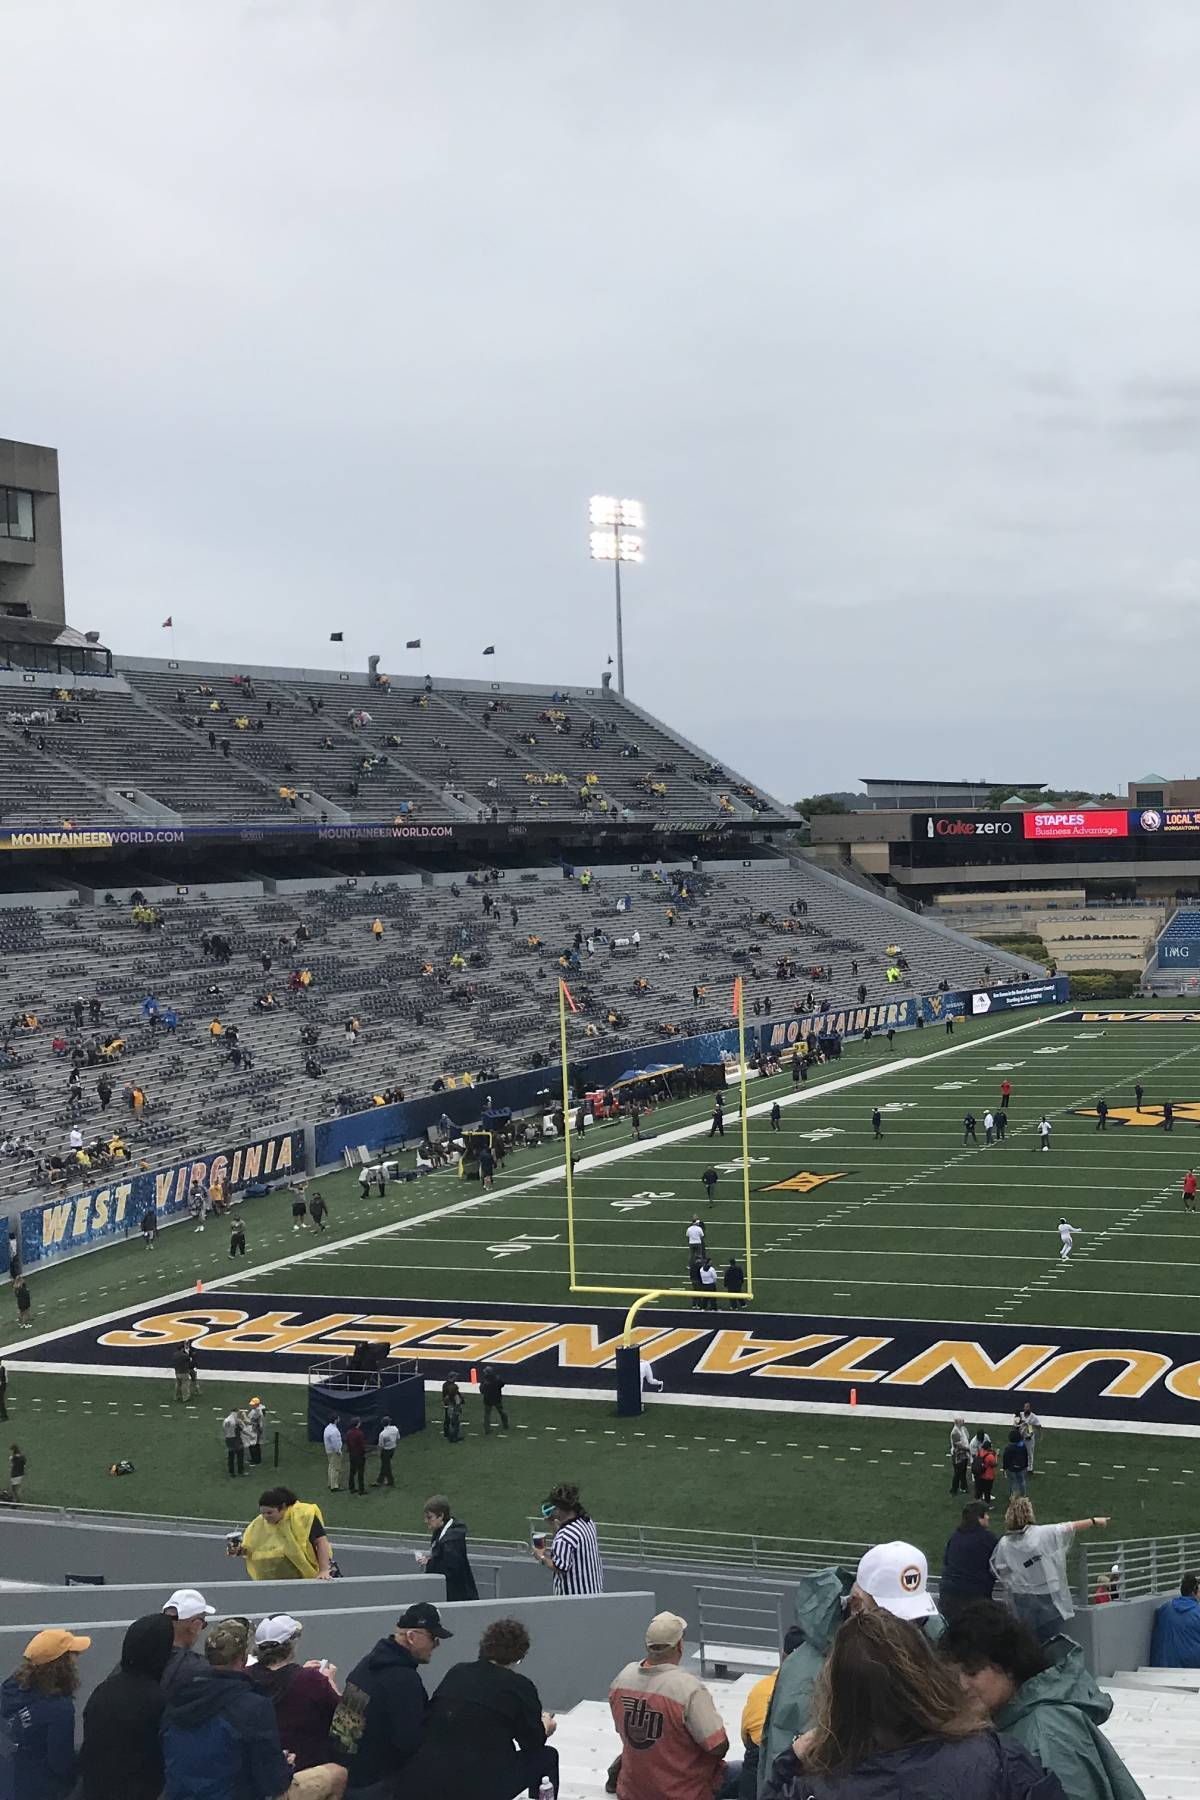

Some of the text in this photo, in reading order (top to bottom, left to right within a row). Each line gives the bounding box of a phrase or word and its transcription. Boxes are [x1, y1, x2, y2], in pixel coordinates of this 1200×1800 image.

[1034, 814, 1085, 826] STAPLES
[1166, 814, 1192, 824] LOCAL
[318, 827, 453, 840] MOUNTAINEERWORLD.COM
[936, 819, 1012, 836] Coke zero
[1035, 826, 1118, 837] Business Advantage
[11, 831, 185, 847] MOUNTAINEERWORLD.COM
[1164, 946, 1189, 958] IMG
[770, 1001, 908, 1046] MOUNTAINEERS
[41, 1136, 293, 1247] WEST VIRGINIA
[486, 1233, 561, 1253] 10
